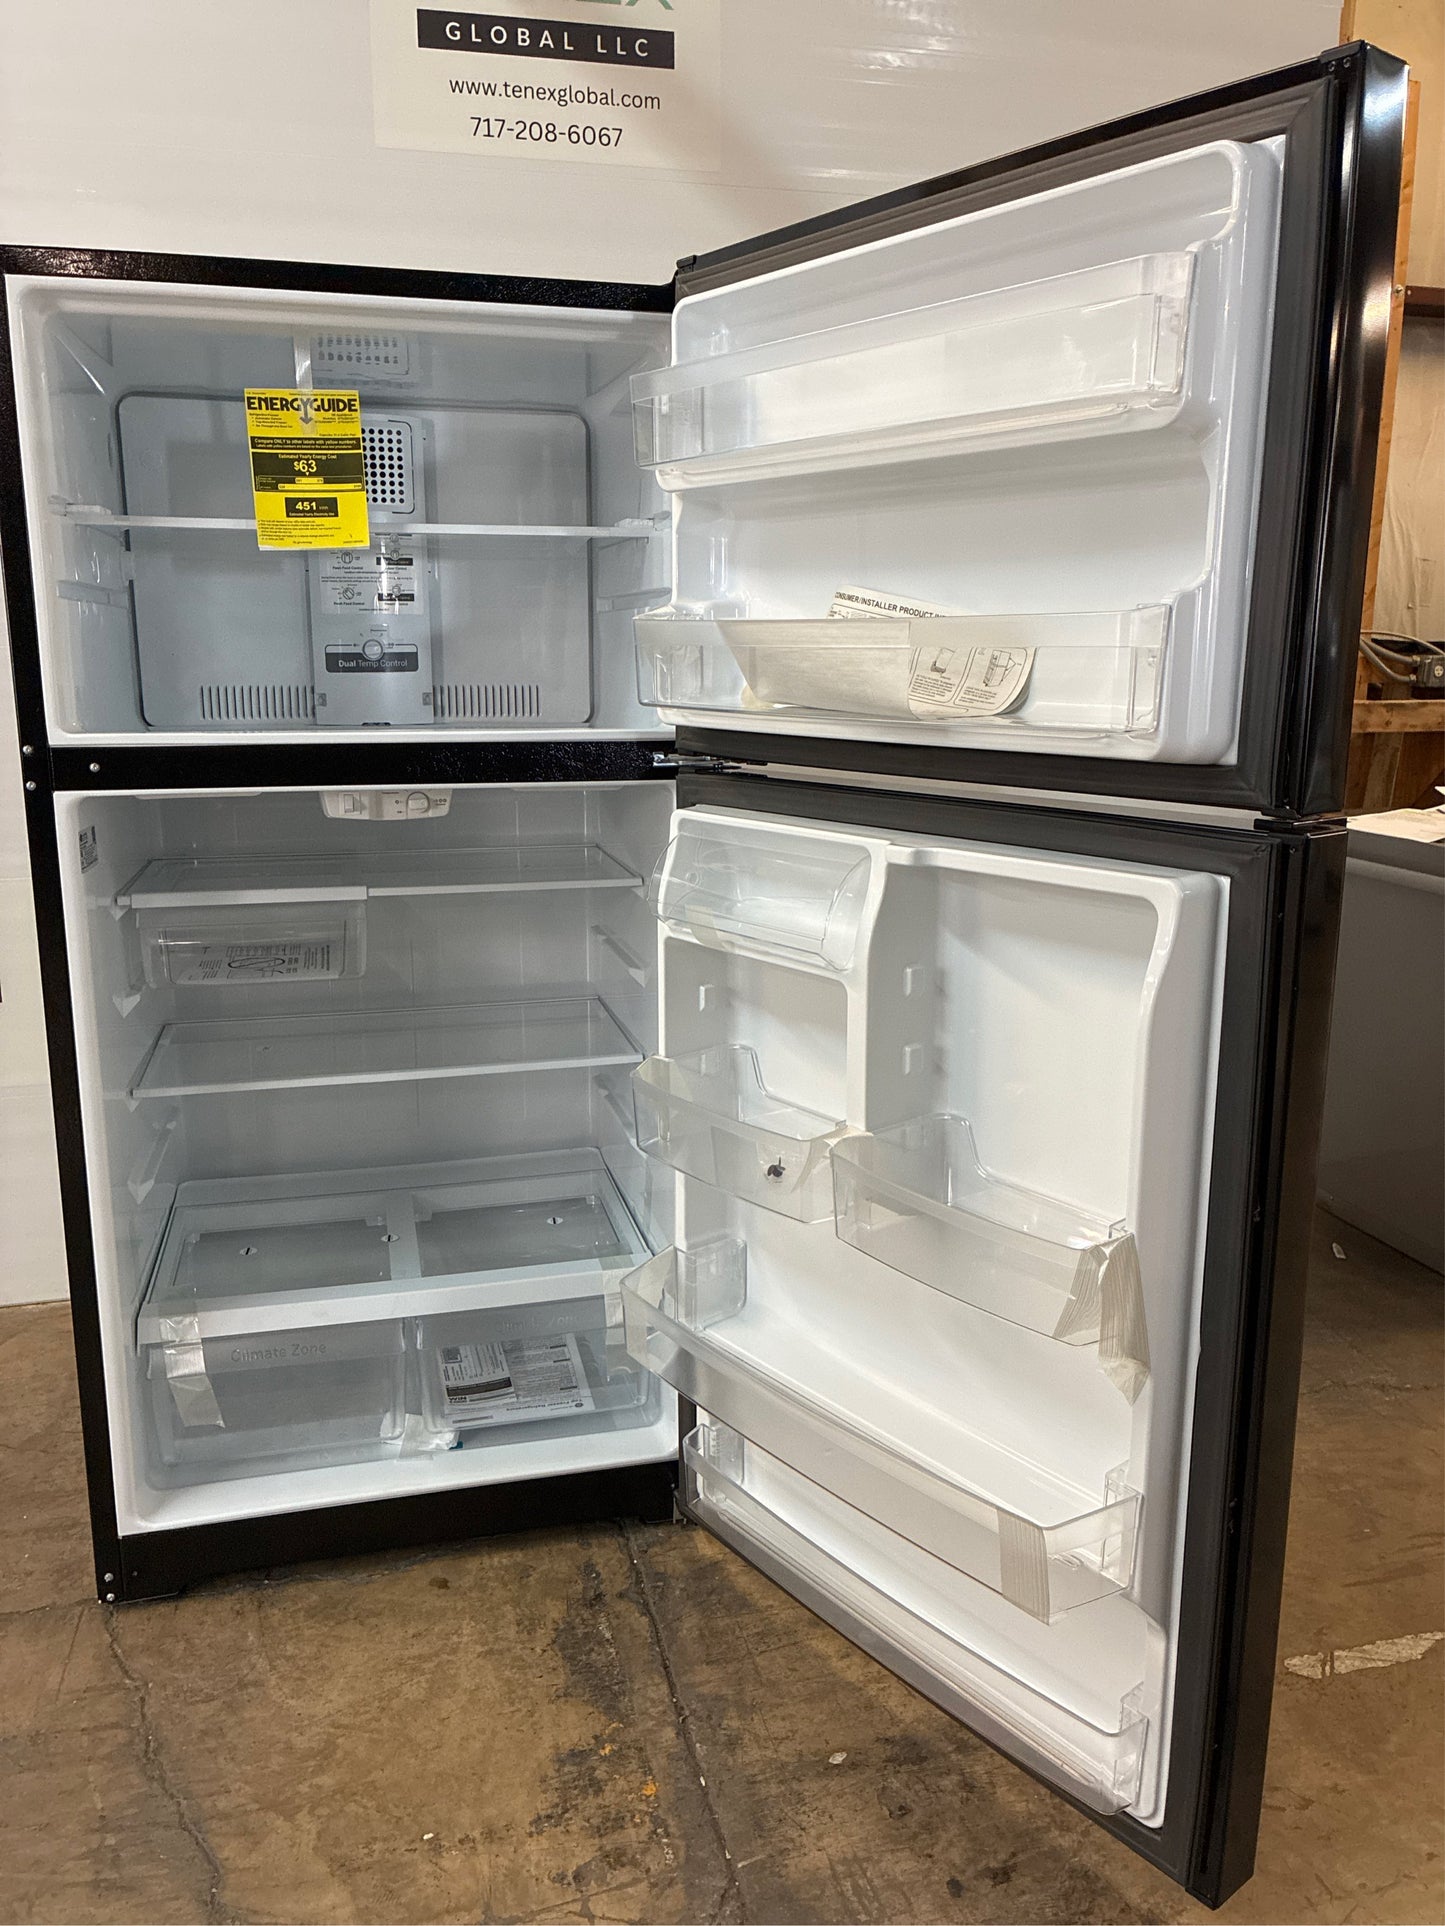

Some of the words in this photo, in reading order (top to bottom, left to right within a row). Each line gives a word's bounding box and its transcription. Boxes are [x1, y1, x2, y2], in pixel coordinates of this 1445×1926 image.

[445, 21, 574, 51] GLOBAL
[596, 34, 649, 57] LLC
[449, 79, 661, 110] www.tenexglobal.com
[470, 116, 623, 148] 717-208-6067
[246, 396, 358, 412] ENERGYGUIDE
[293, 460, 317, 473] $63
[295, 501, 317, 511] 451
[338, 660, 356, 668] Dual
[357, 659, 379, 668] Temp
[380, 659, 408, 667] Control
[231, 1347, 287, 1362] Climate
[291, 1343, 327, 1356] Zone
